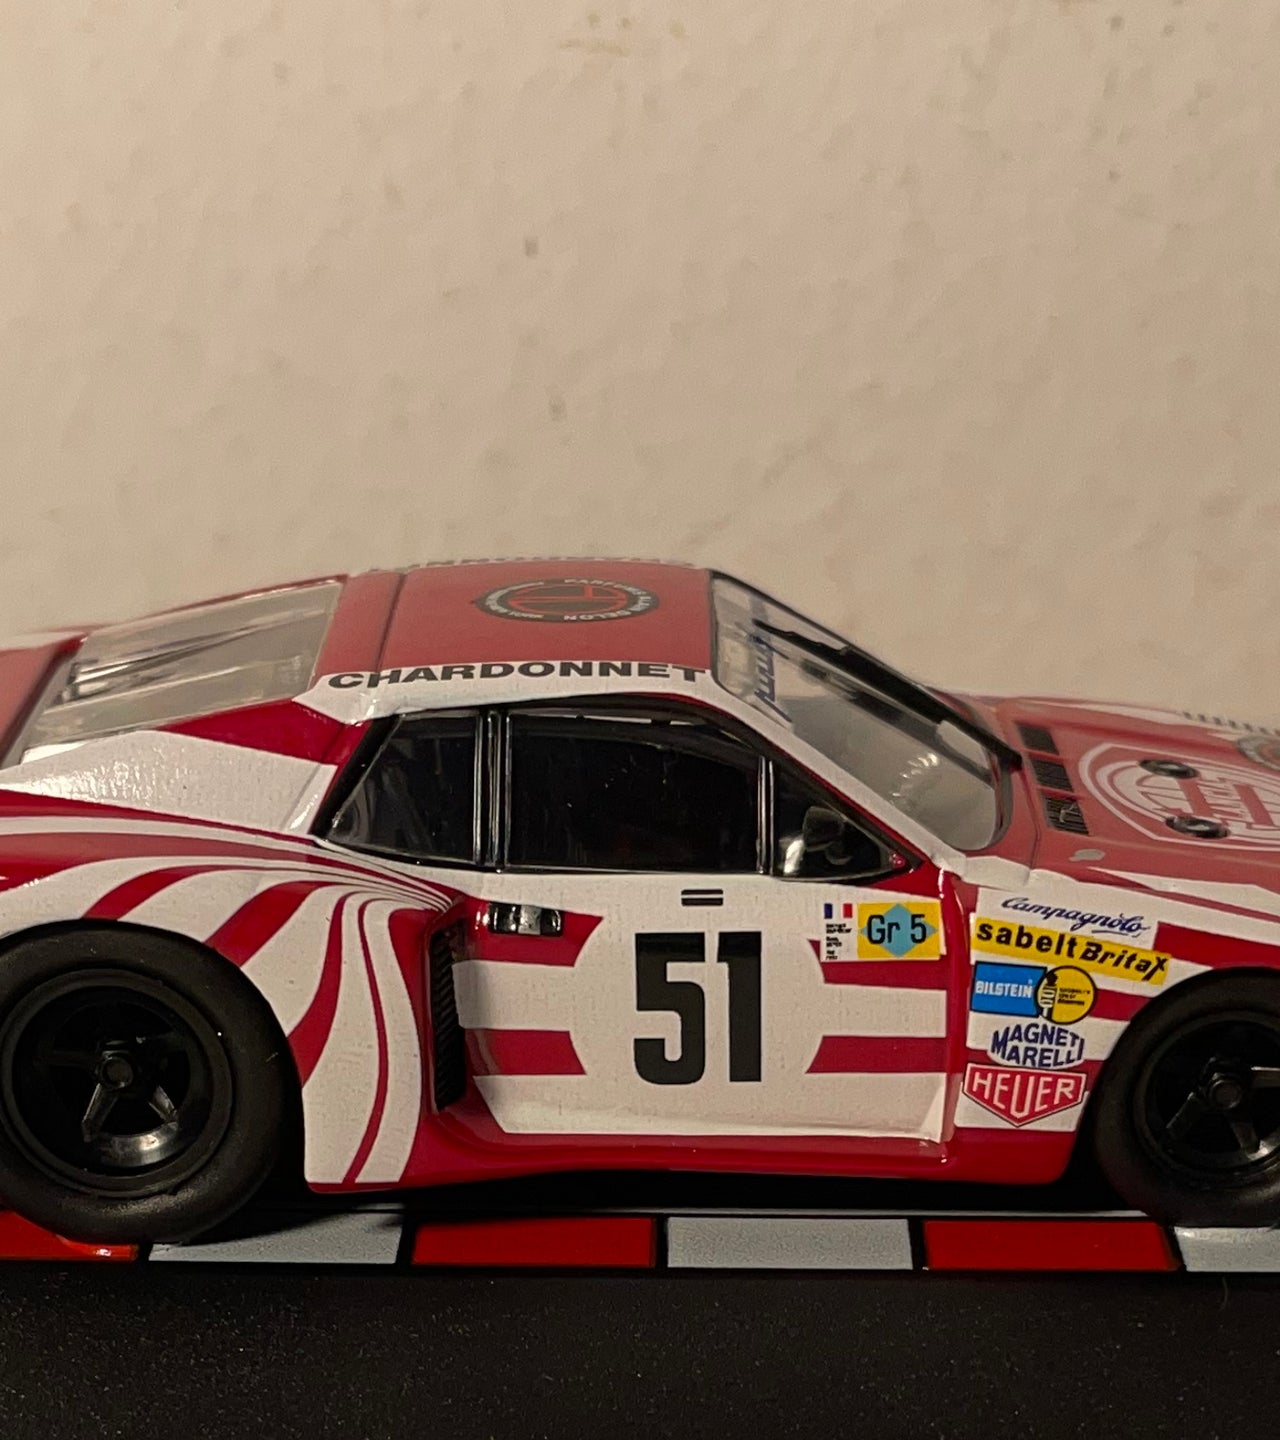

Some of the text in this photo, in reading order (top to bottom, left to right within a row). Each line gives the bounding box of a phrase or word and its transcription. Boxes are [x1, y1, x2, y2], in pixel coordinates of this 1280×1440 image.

[328, 661, 706, 688] CHARDONNET
[867, 914, 901, 945] Gr
[911, 914, 927, 943] 5
[1001, 897, 1150, 937] Campagnolo
[977, 922, 1168, 981] sabelt Britax
[975, 980, 1033, 998] BILSTEIN
[634, 931, 762, 1085] 51
[991, 1023, 1085, 1053] MAGNETI
[972, 1071, 1075, 1119] HEUER
